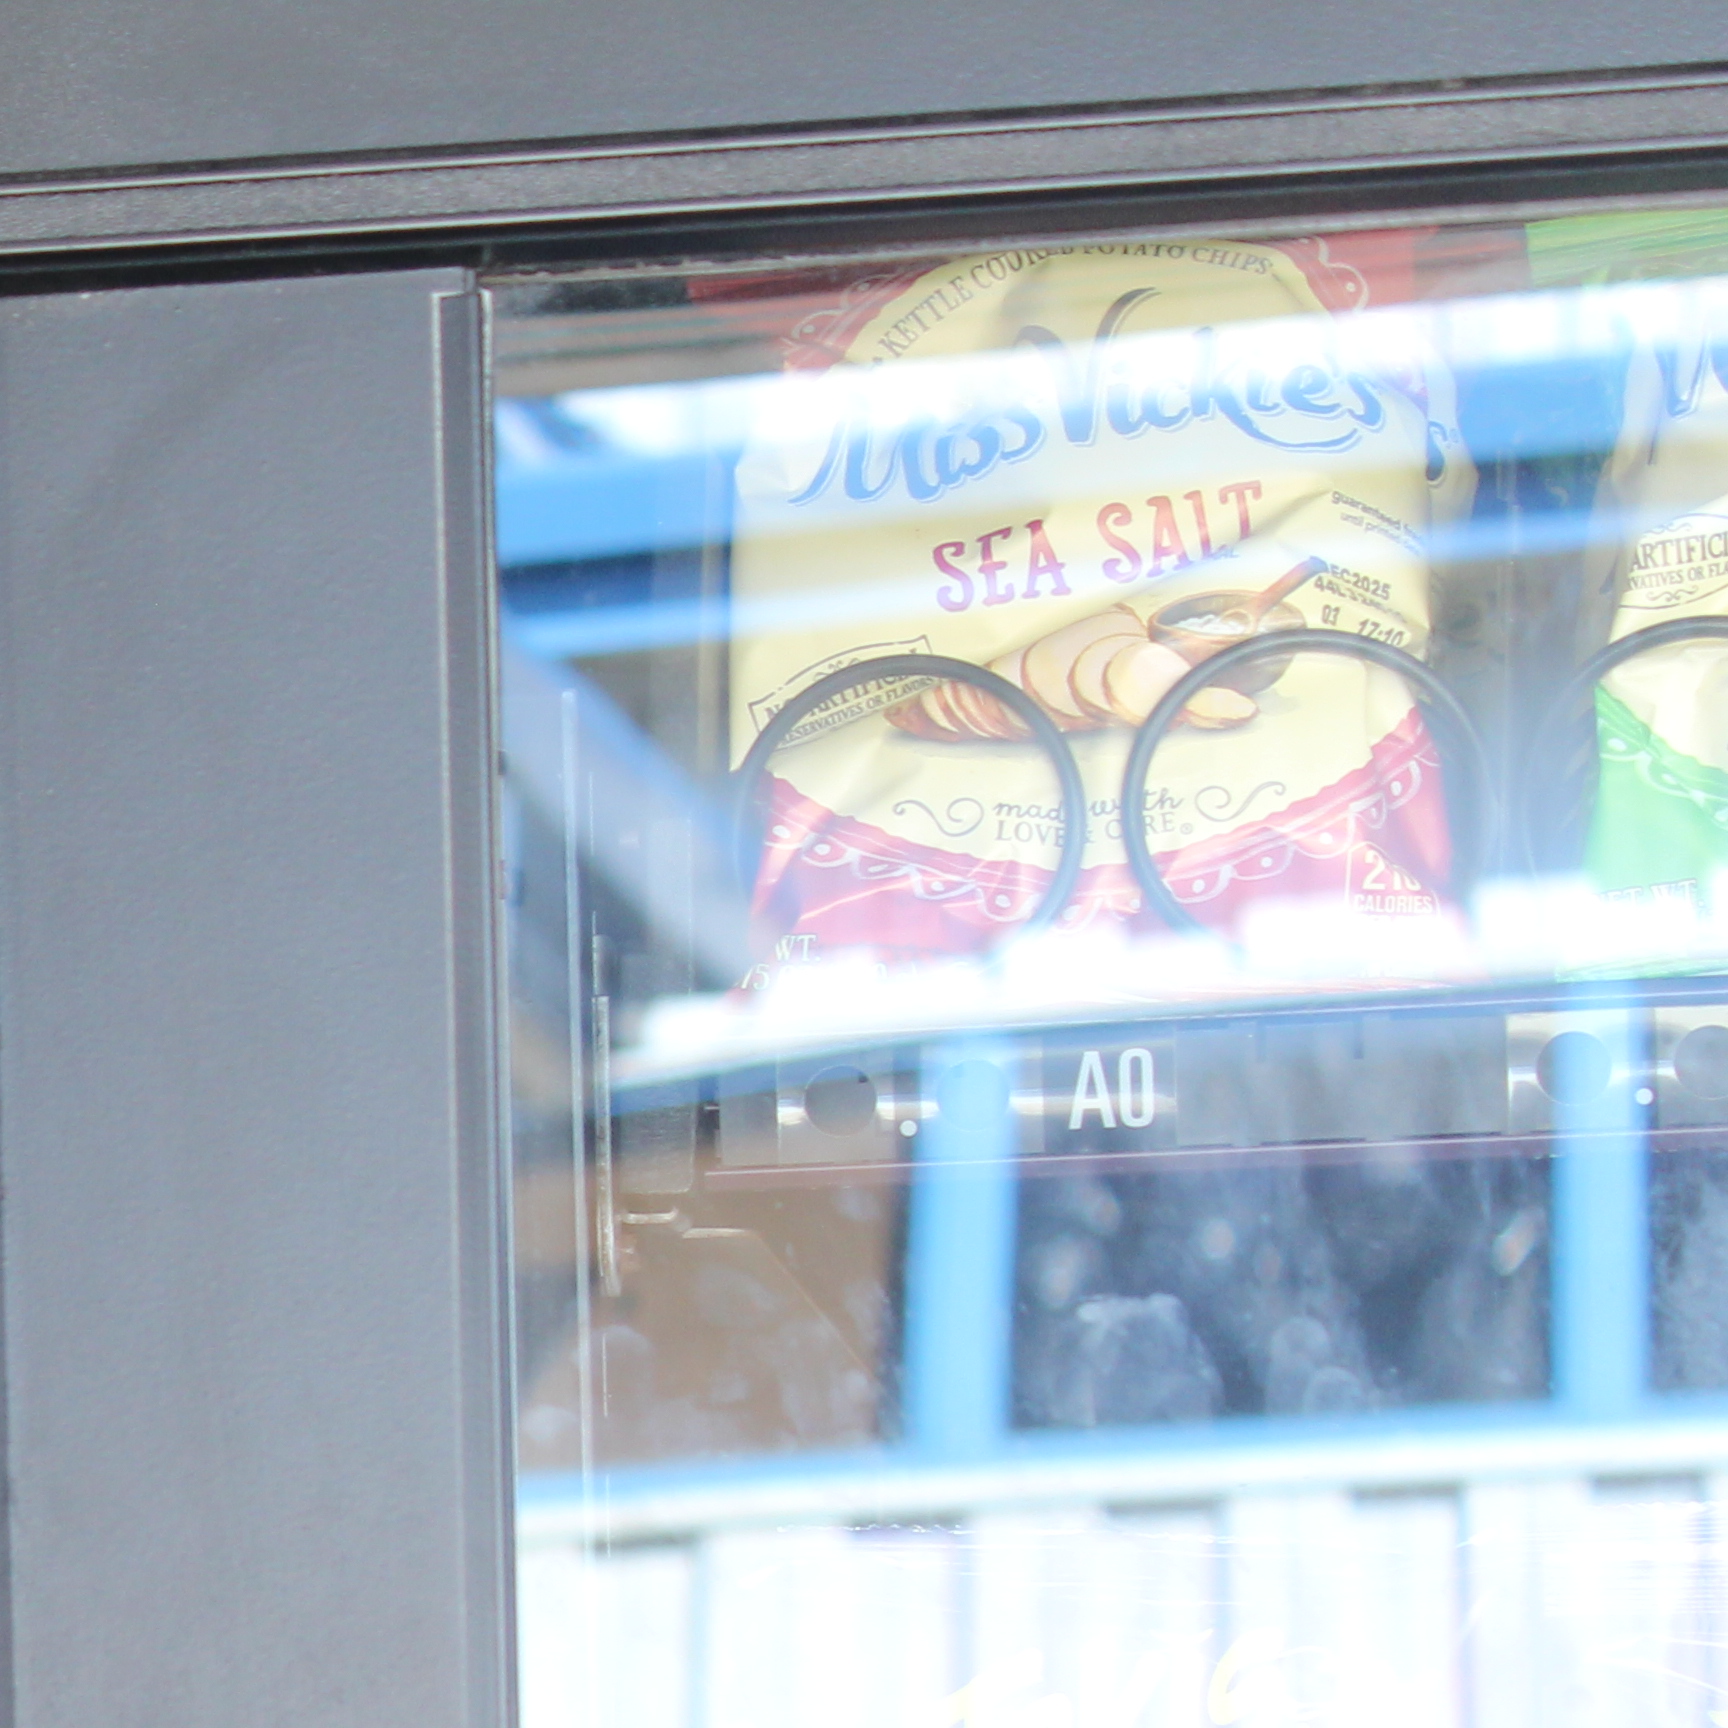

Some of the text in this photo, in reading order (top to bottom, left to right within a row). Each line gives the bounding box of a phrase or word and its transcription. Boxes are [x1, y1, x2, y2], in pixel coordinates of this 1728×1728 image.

[879, 246, 1274, 358] KETTLE CHIPS
[932, 480, 1263, 613] SEA SALT
[867, 694, 885, 711] OR
[1353, 893, 1434, 914] CALORIES
[1069, 1049, 1156, 1131] A0
